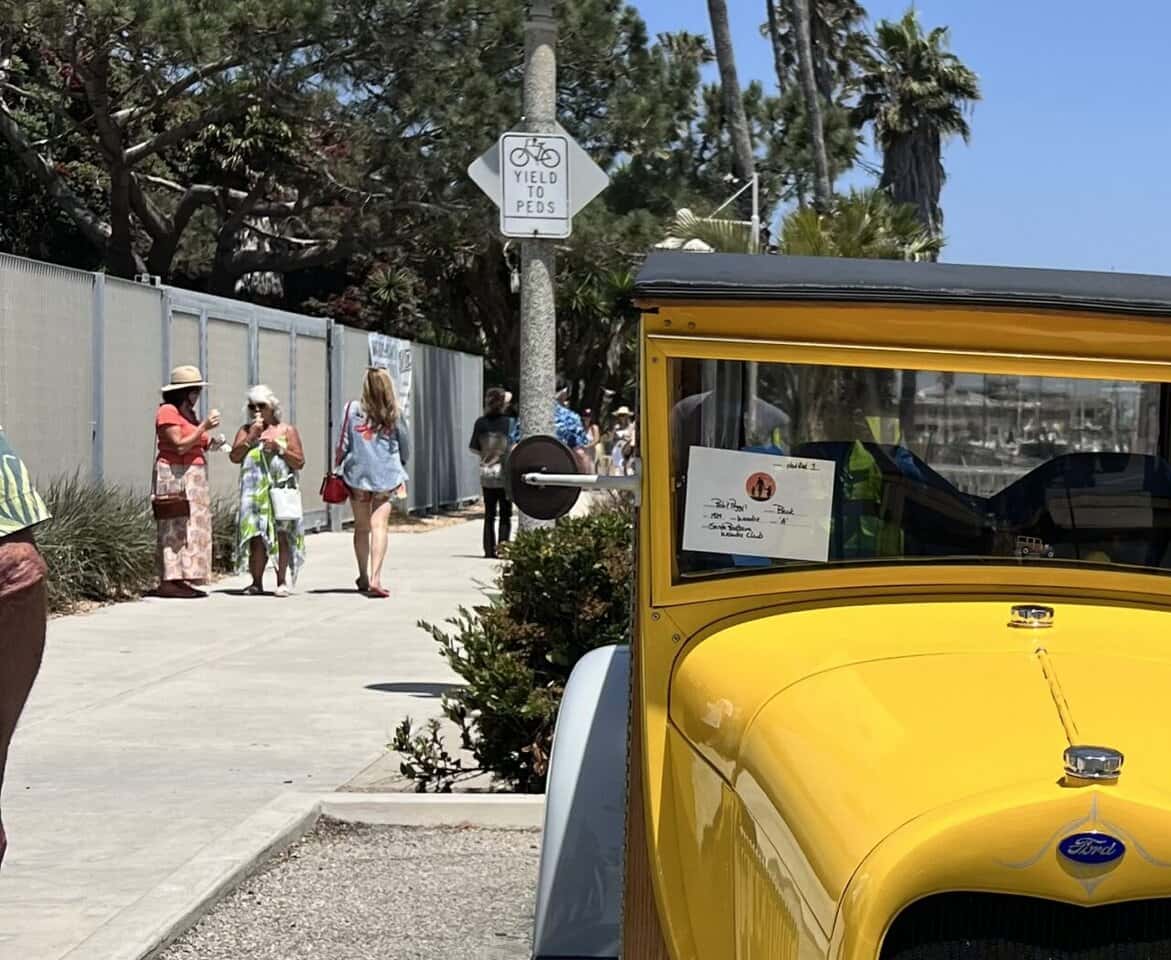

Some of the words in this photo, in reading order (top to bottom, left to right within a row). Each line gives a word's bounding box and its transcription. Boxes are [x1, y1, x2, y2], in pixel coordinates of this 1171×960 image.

[514, 170, 558, 185] YIELD
[527, 185, 544, 199] TO
[516, 200, 555, 214] PEDS
[1067, 837, 1116, 856] Ford
